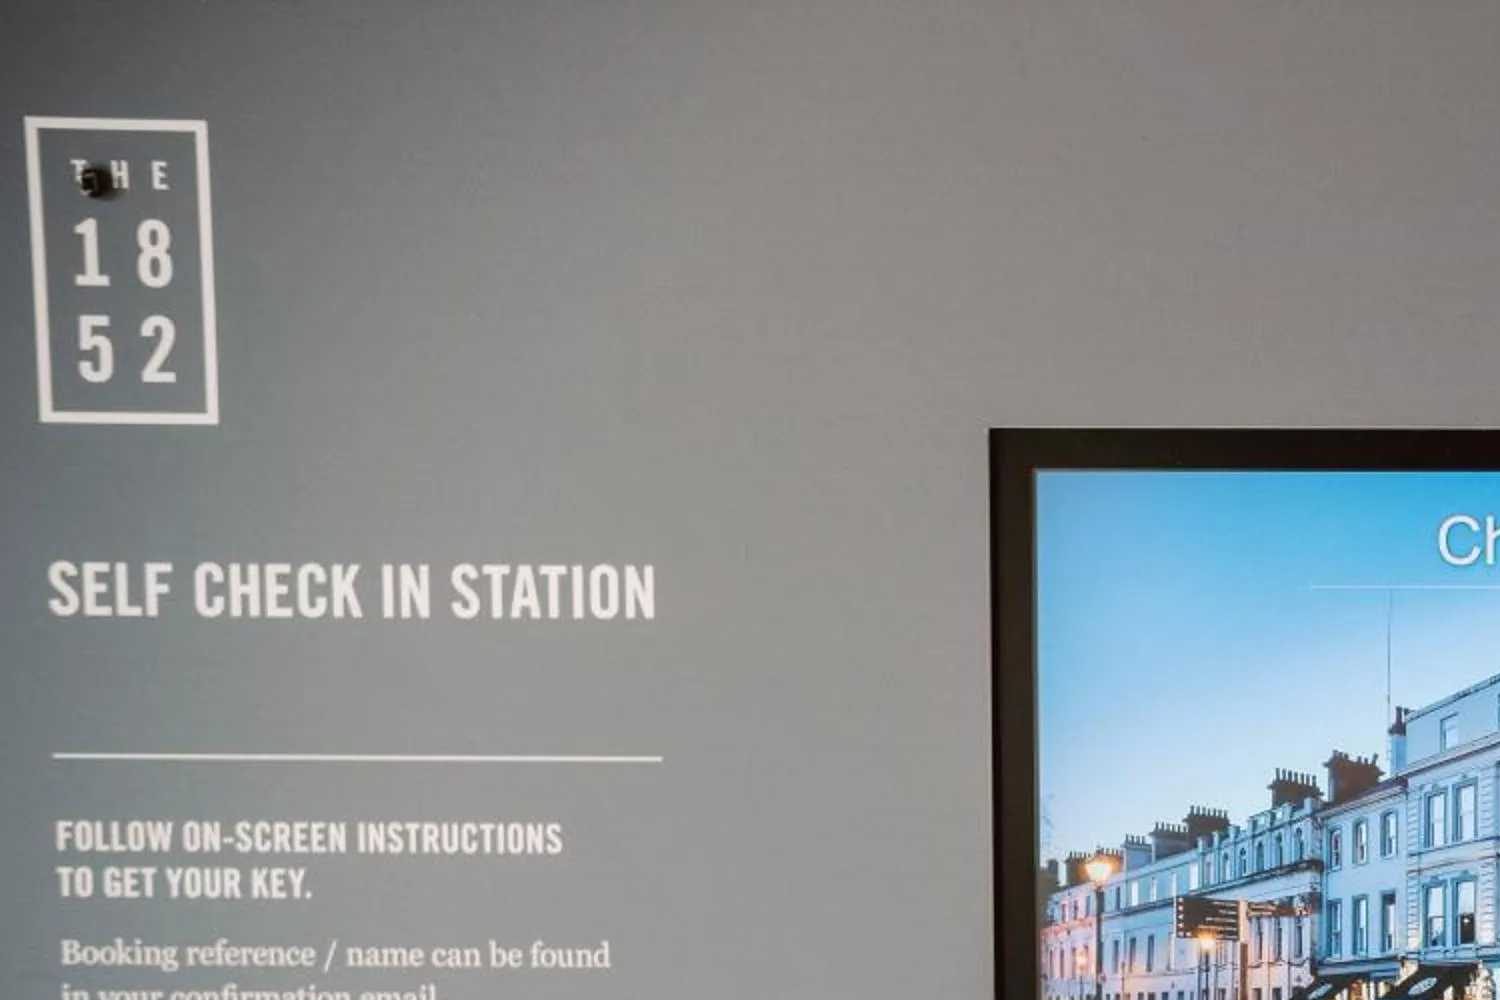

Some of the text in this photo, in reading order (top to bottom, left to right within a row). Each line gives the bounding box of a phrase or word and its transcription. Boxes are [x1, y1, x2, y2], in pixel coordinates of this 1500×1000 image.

[74, 217, 173, 289] 18
[78, 314, 177, 384] 52
[48, 561, 655, 620] SELF CHECK IN STATION
[56, 820, 563, 855] FOLLOW ON-SCREEN INSTRUCTIONS
[57, 866, 313, 900] TO GET YOUR KEY.
[61, 937, 612, 974] Booking reference / name can be found
